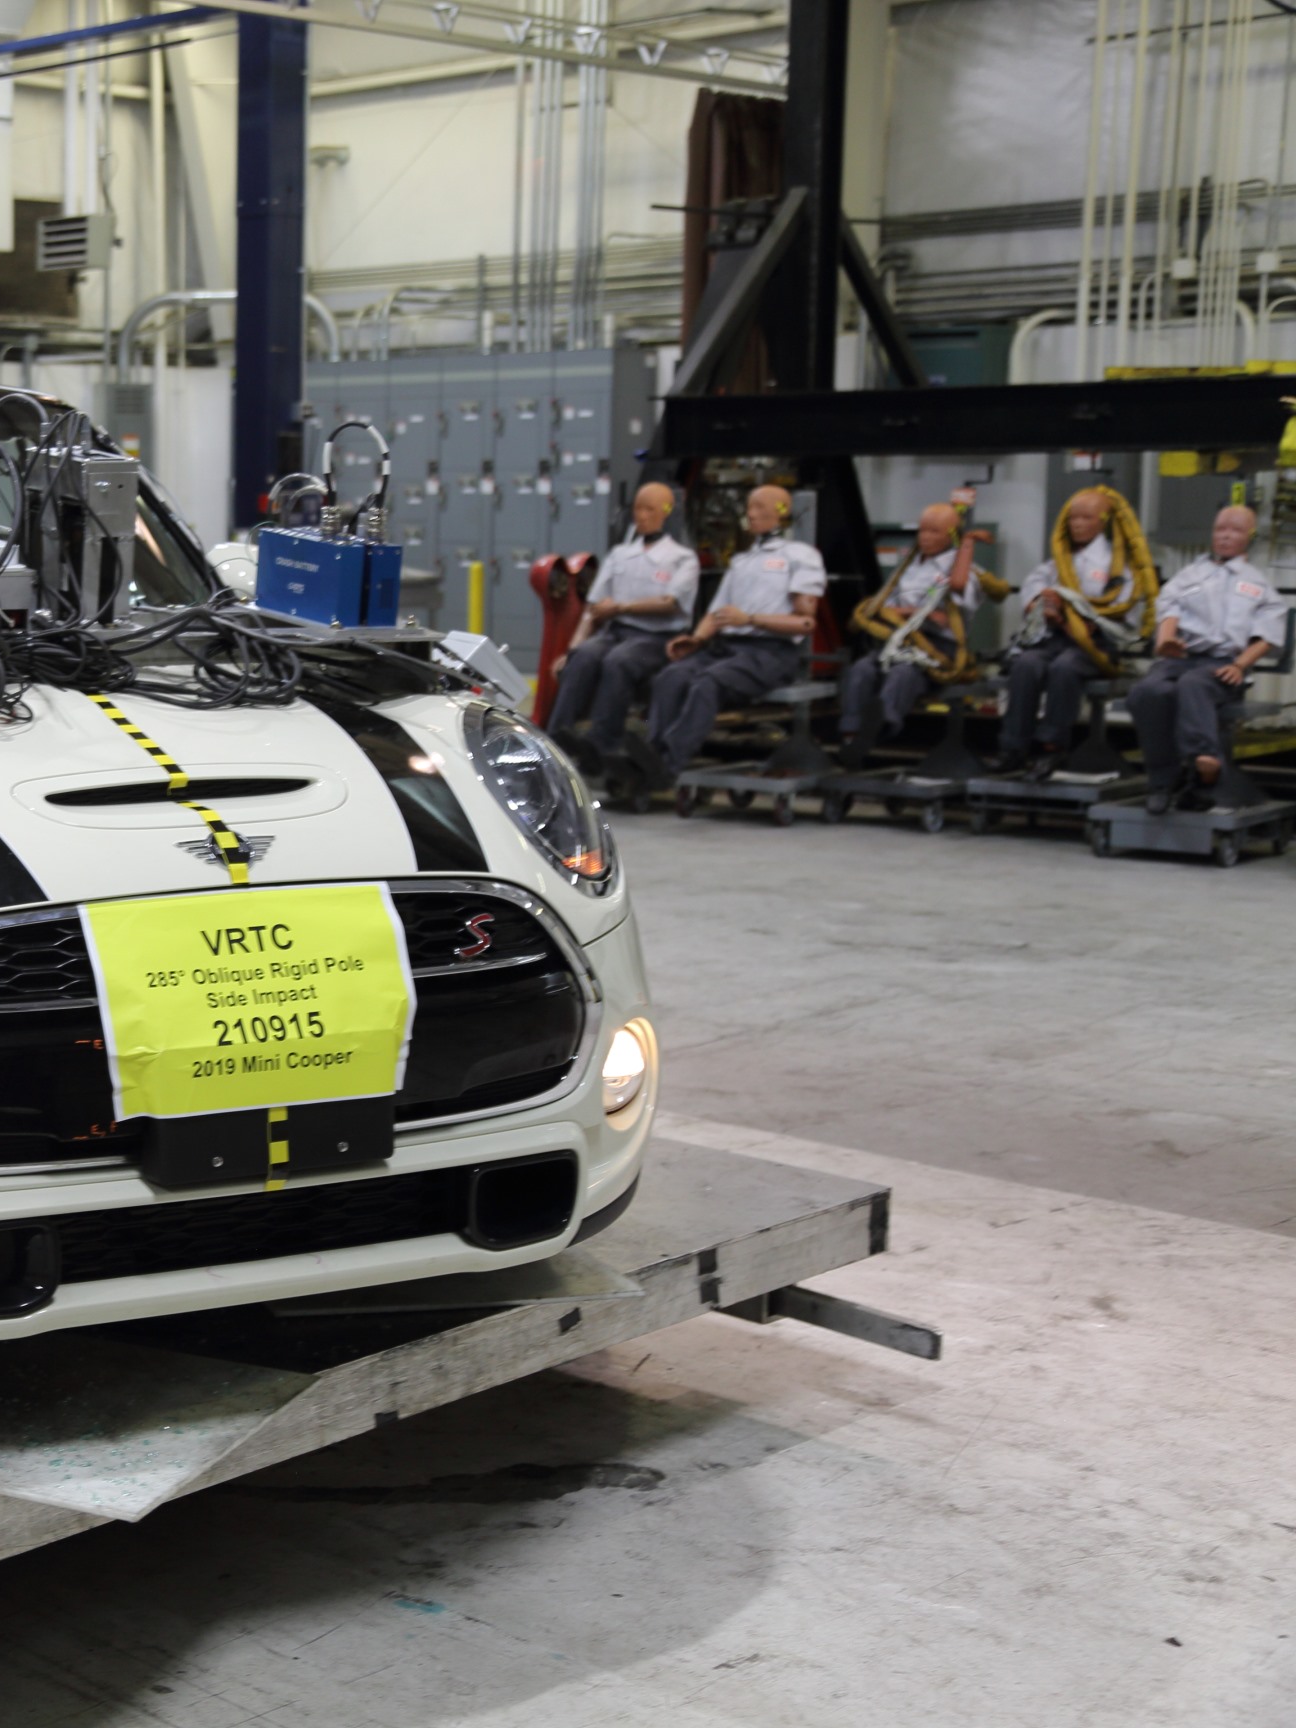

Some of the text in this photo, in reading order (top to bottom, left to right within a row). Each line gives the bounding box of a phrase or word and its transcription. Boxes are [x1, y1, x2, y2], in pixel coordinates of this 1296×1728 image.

[200, 924, 294, 956] VRTC
[454, 913, 495, 957] S
[145, 955, 365, 988] 285° Oblique Rigid Pole
[206, 984, 318, 1009] Side Impact
[213, 1011, 325, 1047] 210915
[192, 1050, 354, 1078] 2019 Mini Cooper
